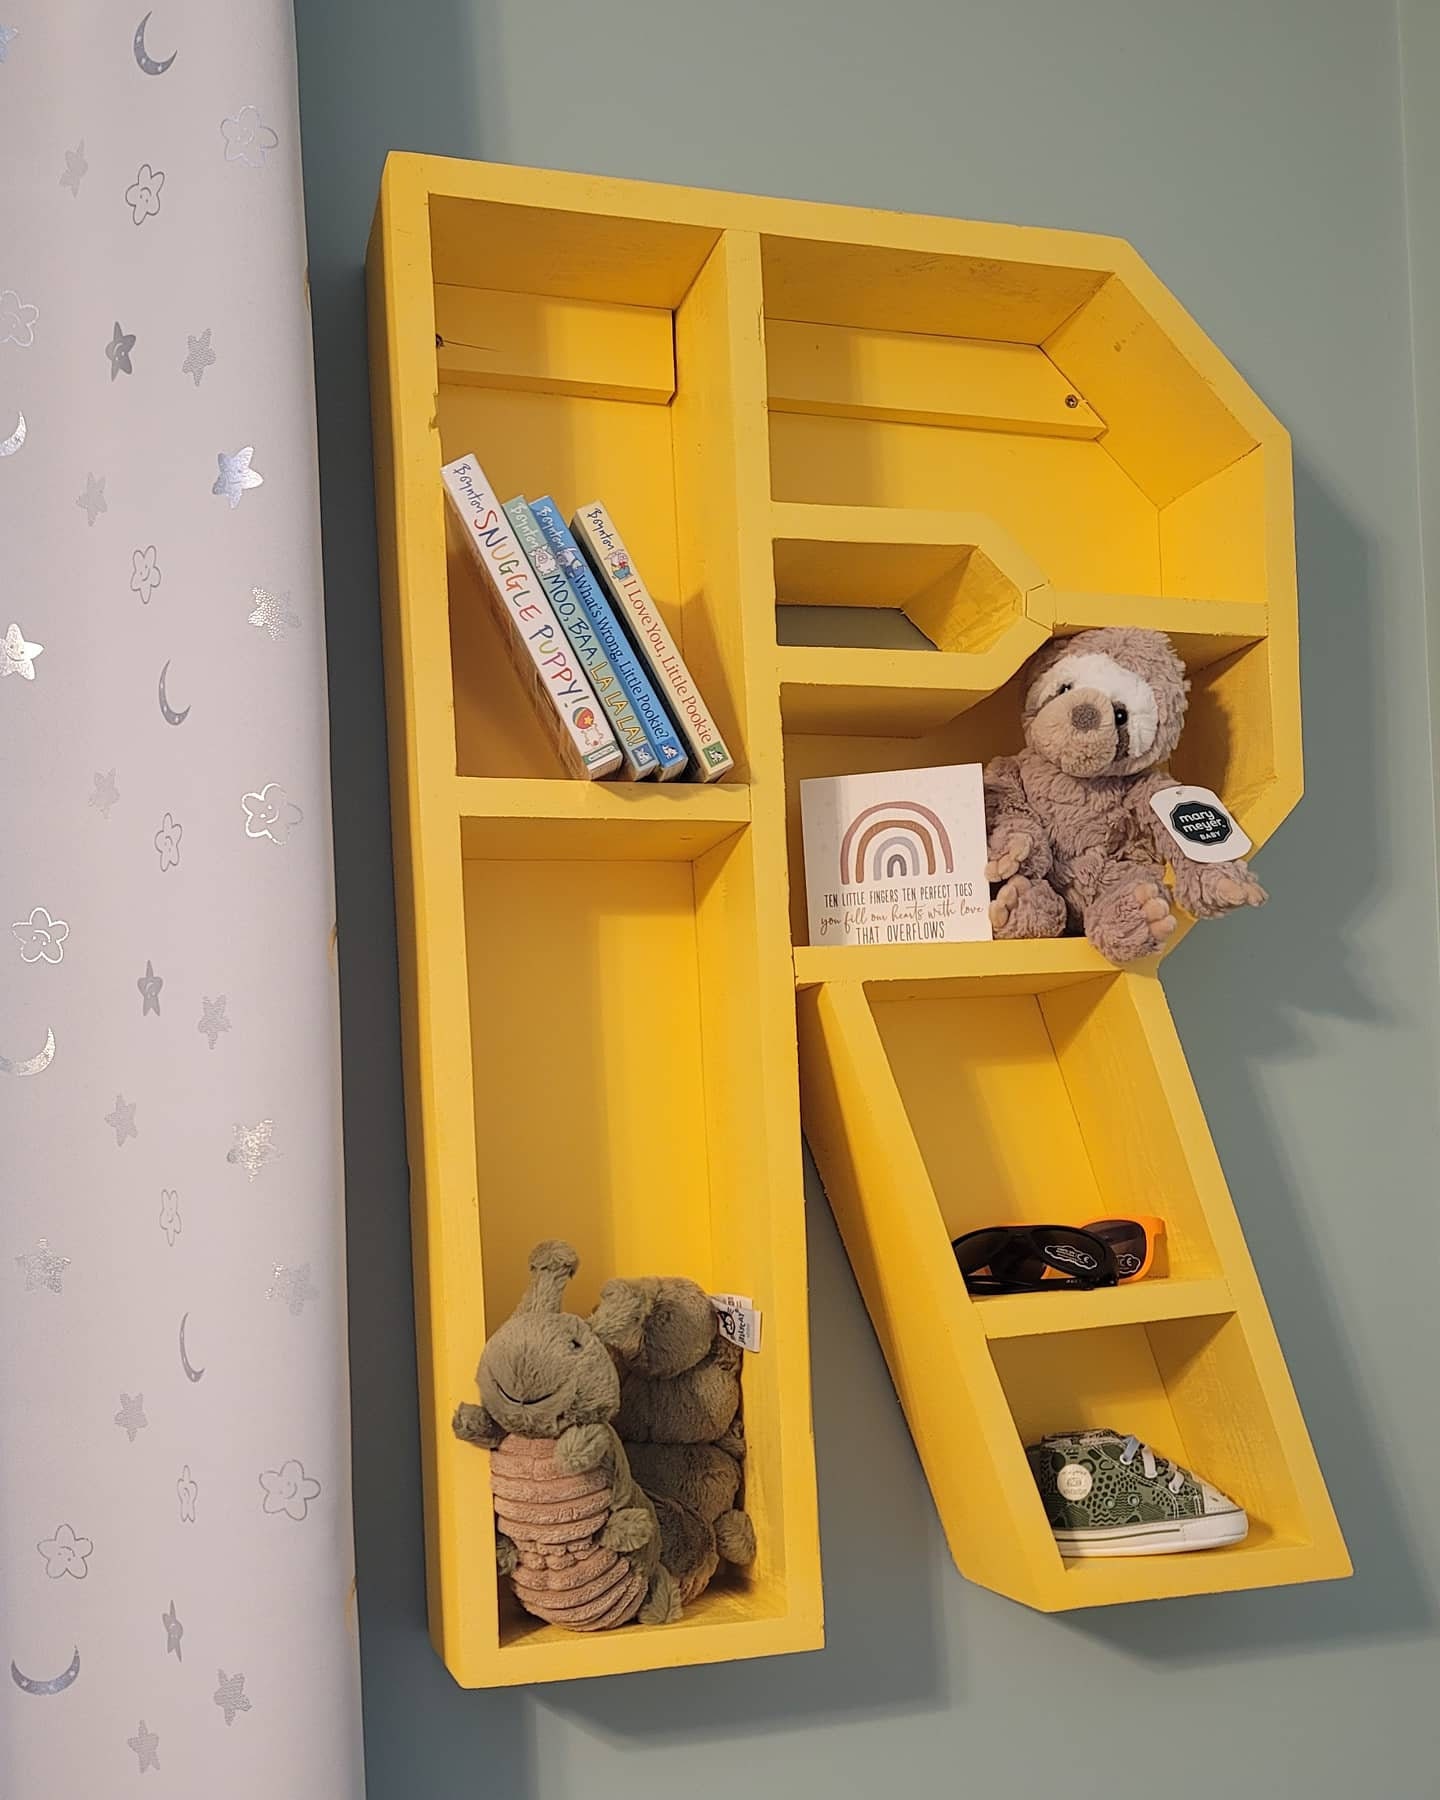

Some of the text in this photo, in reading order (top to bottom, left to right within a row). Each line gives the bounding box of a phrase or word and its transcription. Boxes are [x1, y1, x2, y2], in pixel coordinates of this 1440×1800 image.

[453, 463, 485, 513] Boynton
[510, 502, 539, 548] Boynton
[536, 505, 565, 548] Boynton
[587, 507, 614, 551] Boynton
[474, 510, 590, 708] SNUGGLE PUPPY!
[543, 574, 646, 747] MOO, BAA, LA LA LA!
[575, 574, 669, 740] What's Wrong, Little Pookie?
[623, 580, 712, 744] I Love You, Little Pookie
[1179, 810, 1215, 823] mary
[1182, 818, 1222, 833] meyer
[1200, 831, 1221, 840] BABY
[824, 882, 973, 908] TEN LITTLE FINGERS TEN PERFECT TOES
[820, 899, 984, 936] you fill our hearts with love
[856, 921, 945, 944] THAT OVERFLOWS
